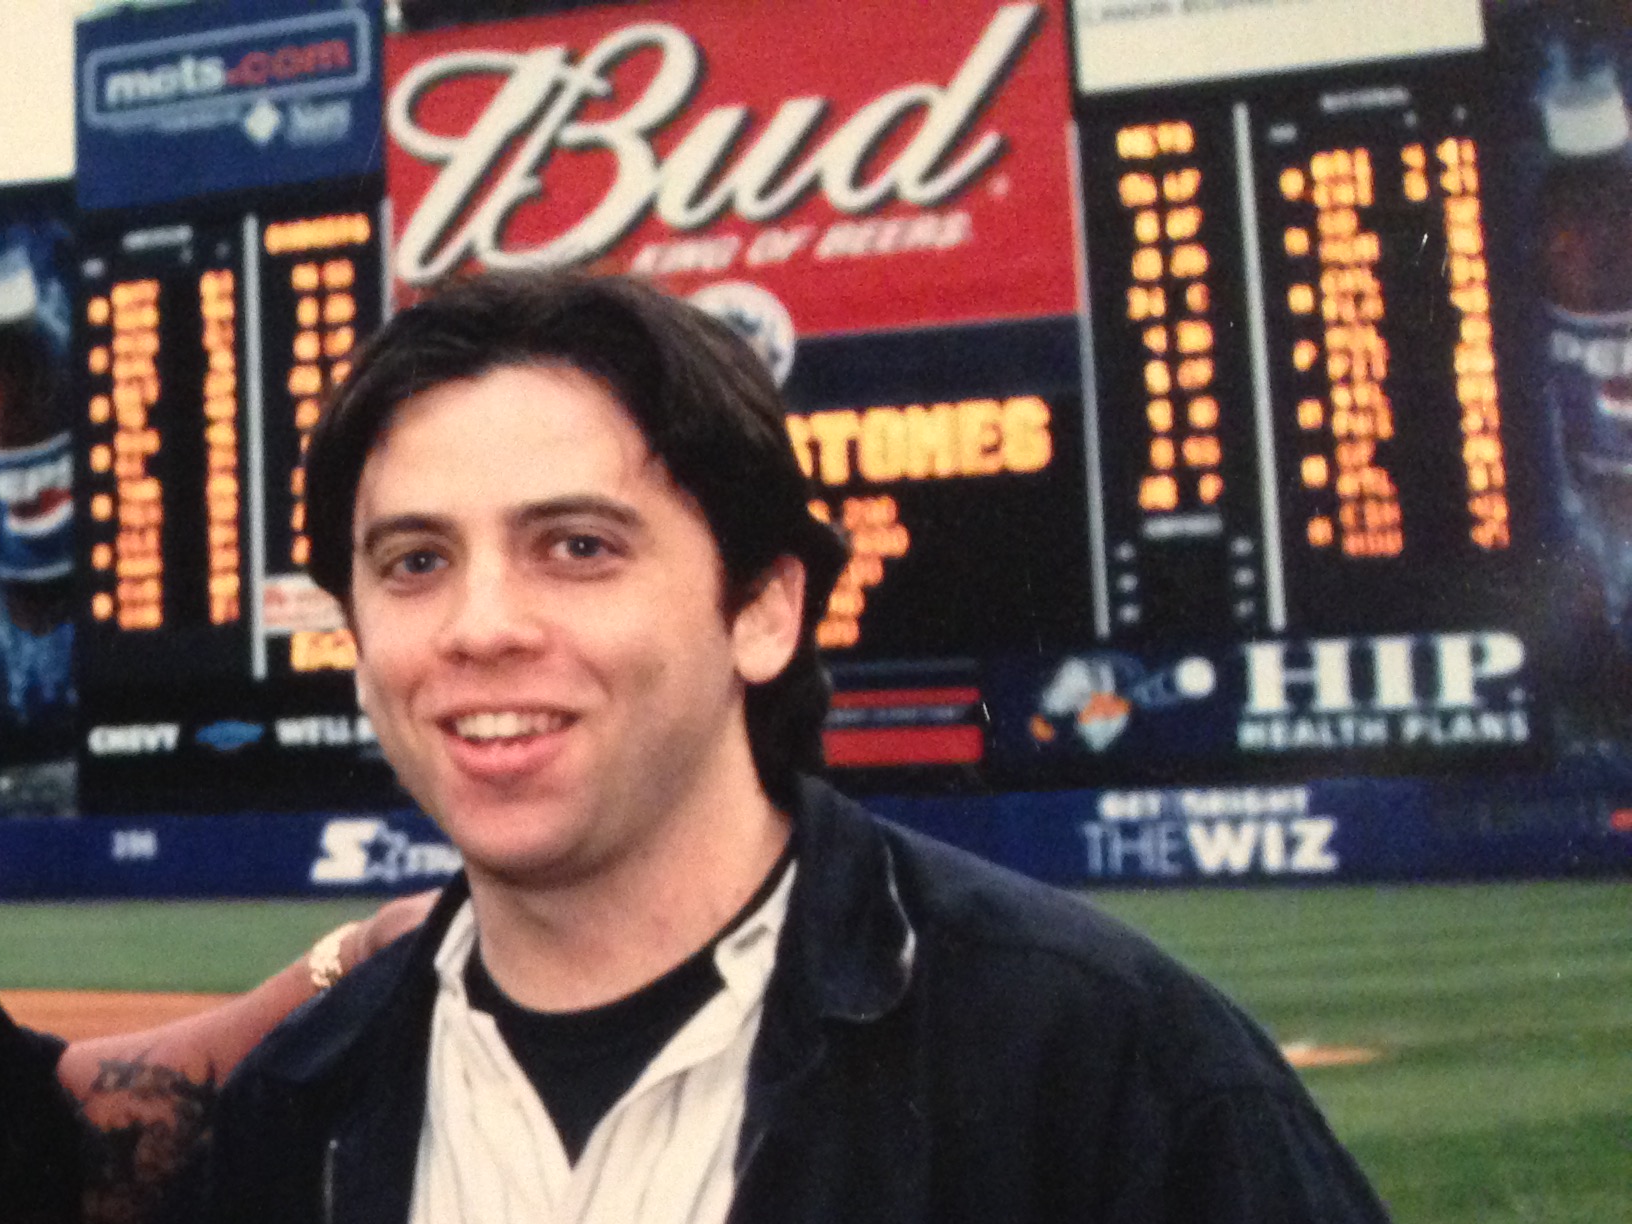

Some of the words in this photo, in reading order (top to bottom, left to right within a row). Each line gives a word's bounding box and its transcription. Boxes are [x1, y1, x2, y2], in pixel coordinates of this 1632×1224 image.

[105, 40, 350, 104] mets.com
[386, 2, 1040, 284] Bud
[1243, 631, 1526, 714] HIP
[1237, 715, 1389, 751] HEALTH
[1399, 711, 1530, 746] PLANS
[1186, 813, 1339, 876] WIZ
